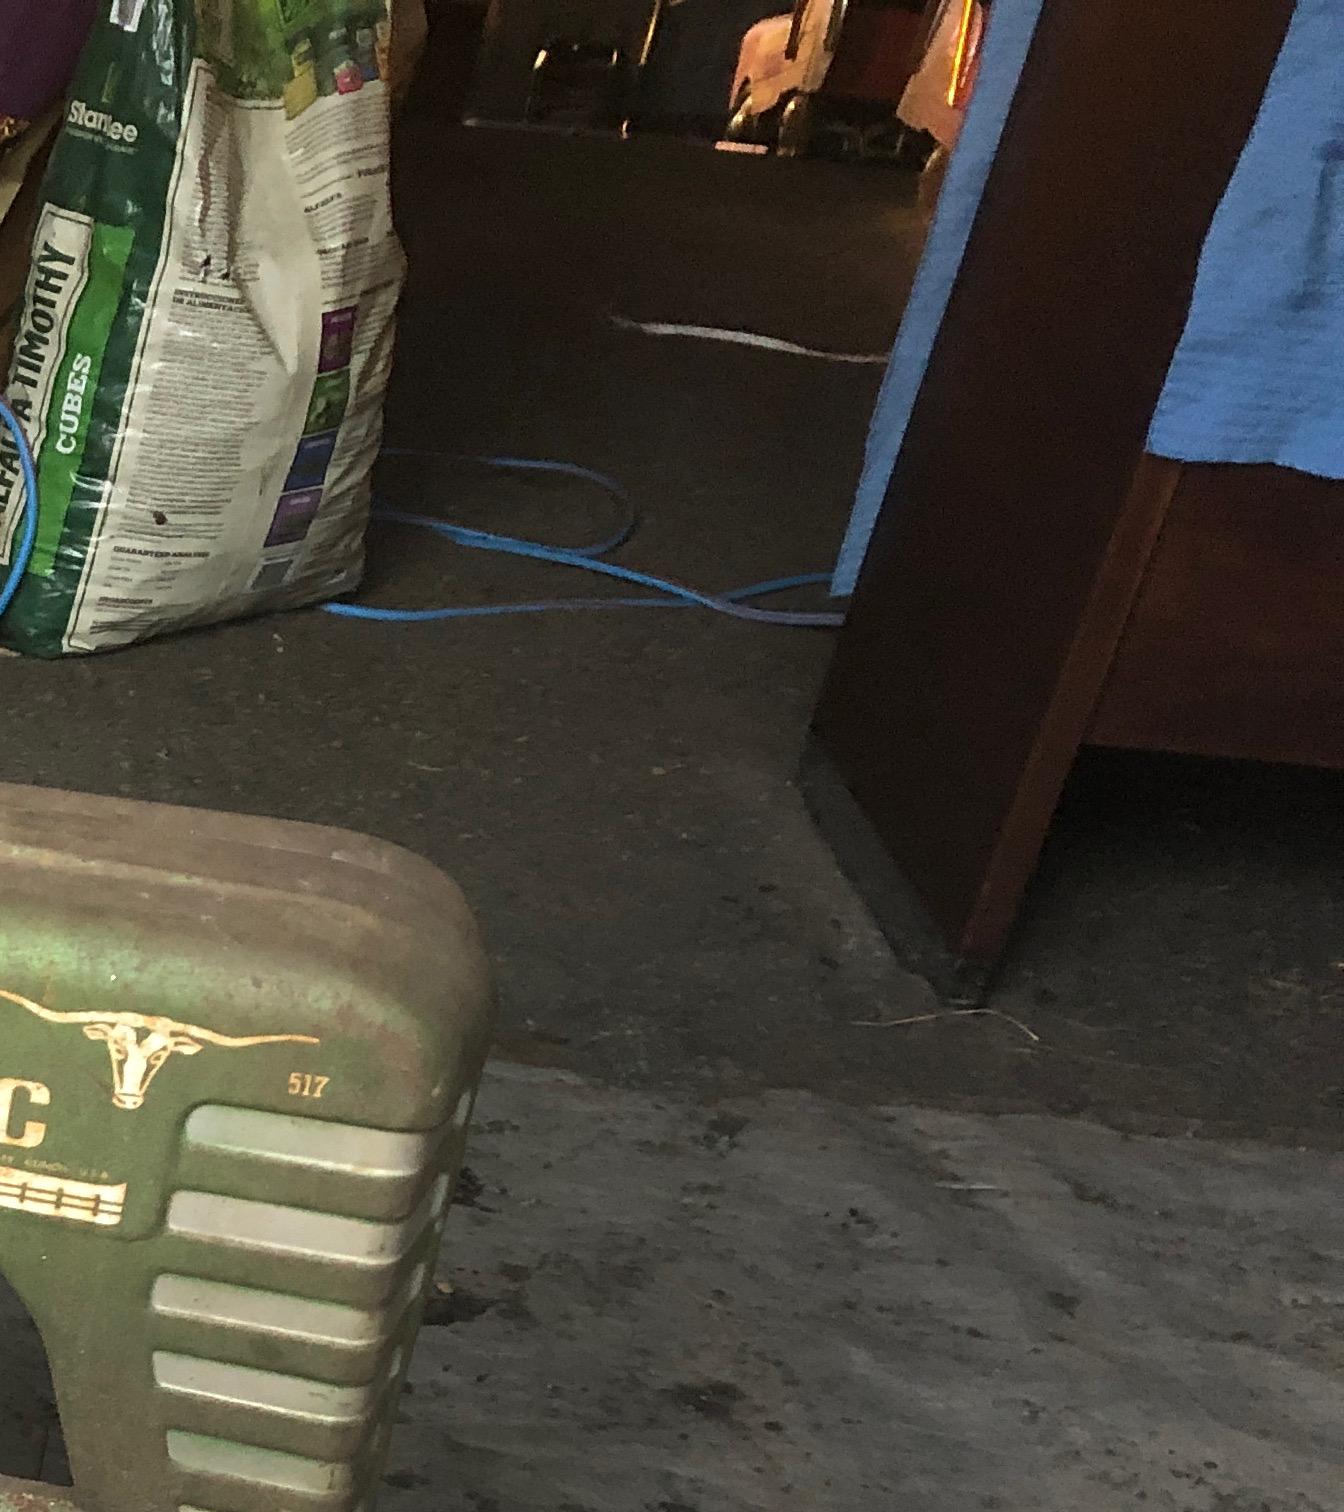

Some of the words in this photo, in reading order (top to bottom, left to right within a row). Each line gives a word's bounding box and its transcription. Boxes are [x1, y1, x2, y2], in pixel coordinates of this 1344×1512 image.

[13, 241, 77, 390] TIMOTHY
[56, 352, 92, 456] CUBES
[287, 1072, 331, 1097] 517
